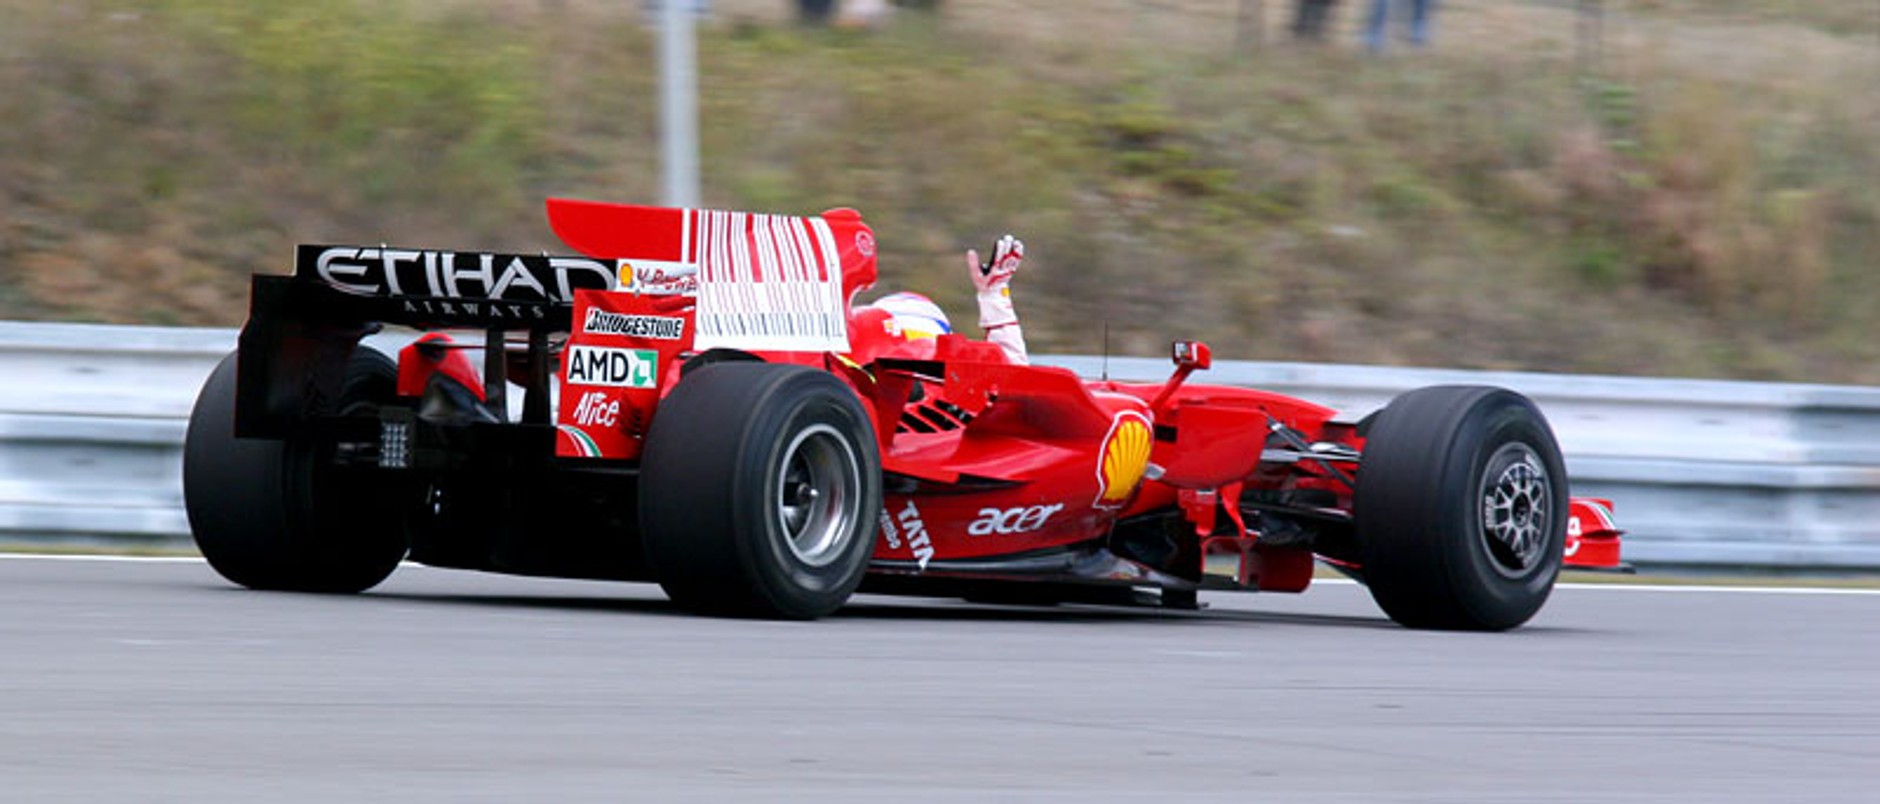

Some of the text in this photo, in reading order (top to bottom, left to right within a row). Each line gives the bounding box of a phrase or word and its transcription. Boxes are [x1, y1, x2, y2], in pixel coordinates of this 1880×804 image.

[315, 247, 617, 304] ETIHAD
[404, 300, 544, 318] AIRWAYS
[585, 308, 683, 338] BRIDGESTONE
[568, 348, 629, 382] AMD
[898, 500, 934, 569] TATA
[968, 502, 1064, 535] acer
